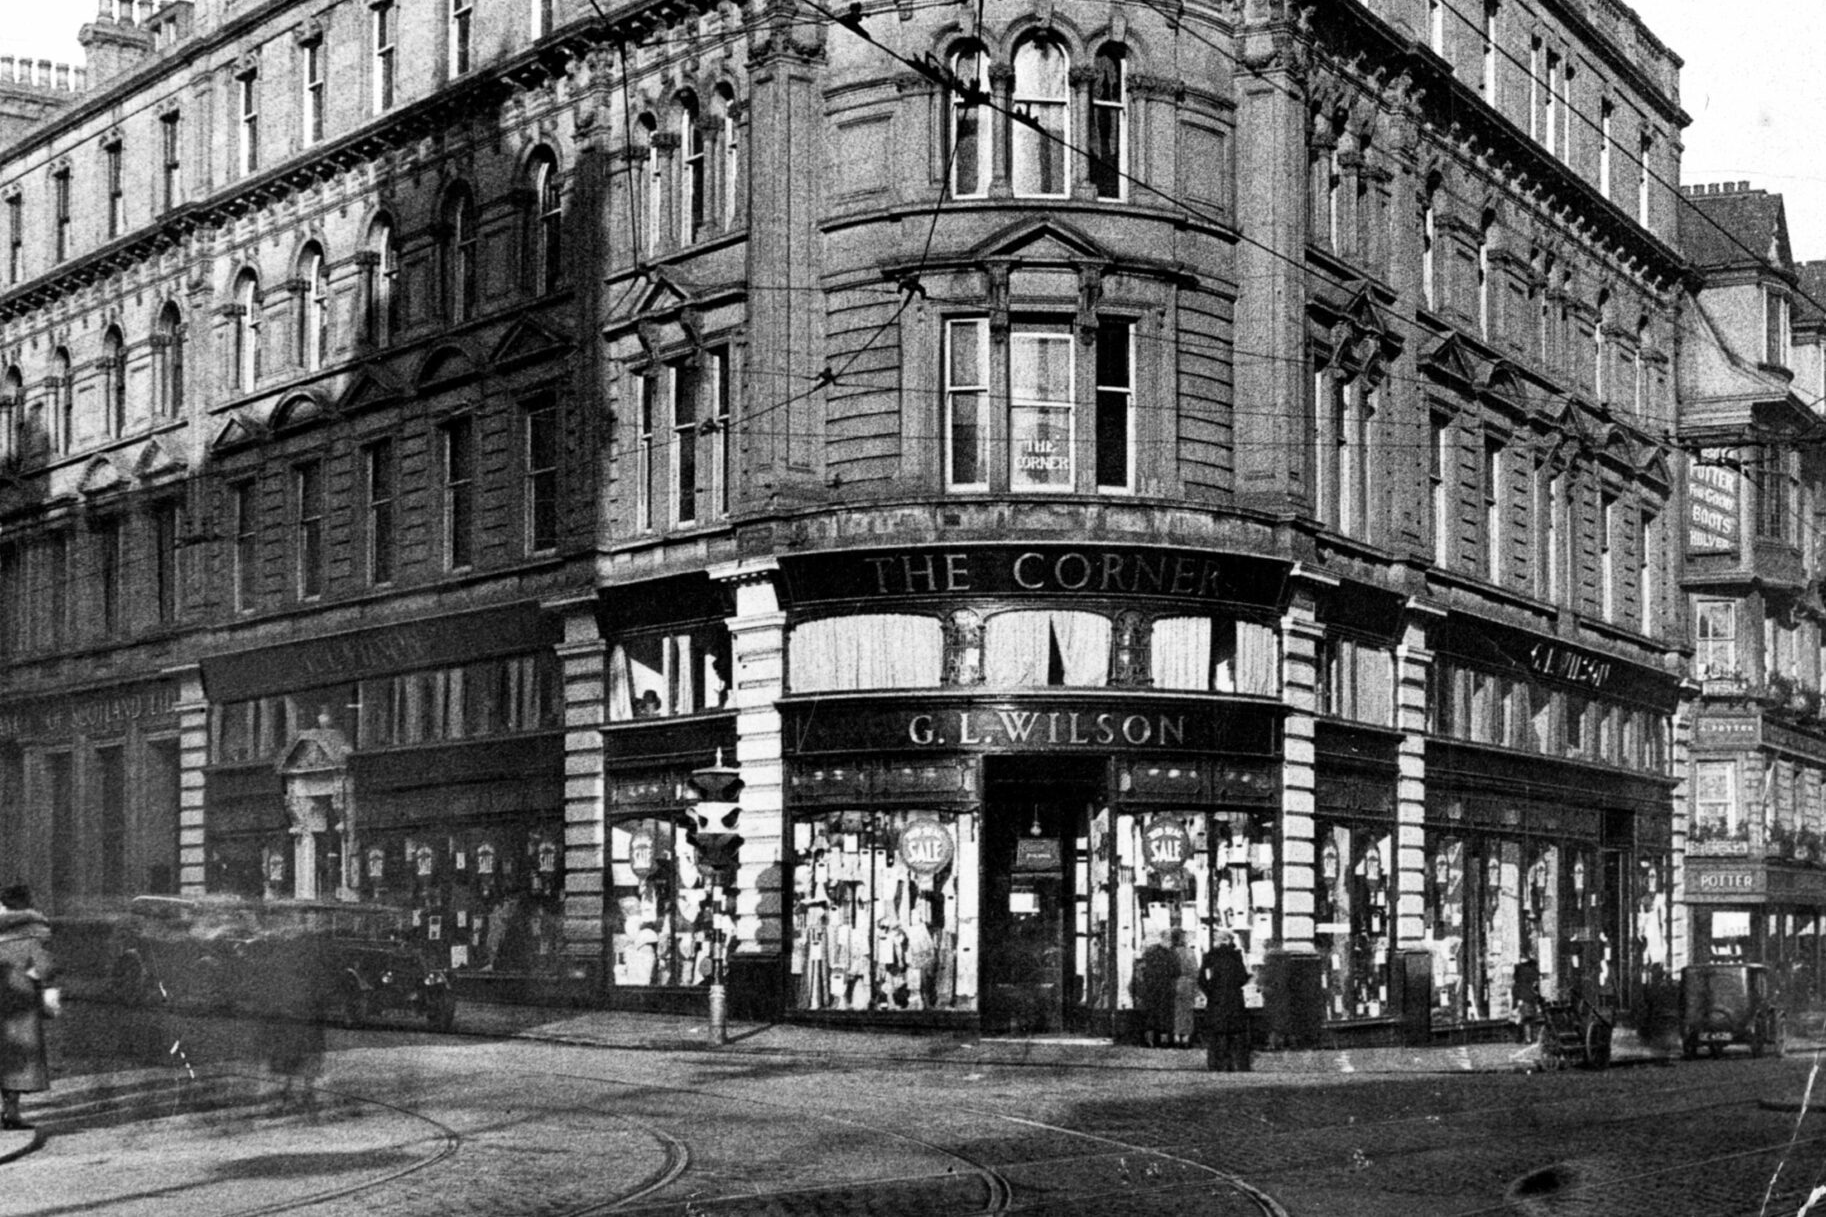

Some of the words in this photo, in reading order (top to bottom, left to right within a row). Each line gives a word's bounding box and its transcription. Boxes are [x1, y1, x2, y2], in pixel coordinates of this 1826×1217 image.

[1027, 439, 1057, 453] THE
[1014, 456, 1070, 470] CORNER
[1692, 504, 1731, 534] BOOTS
[864, 553, 971, 594] THE
[1013, 552, 1224, 597] CORNER
[908, 714, 945, 745] G.
[999, 711, 1185, 746] WILSON
[908, 840, 942, 863] SALE
[1150, 840, 1181, 862] SALE
[1700, 874, 1753, 887] POTTER
